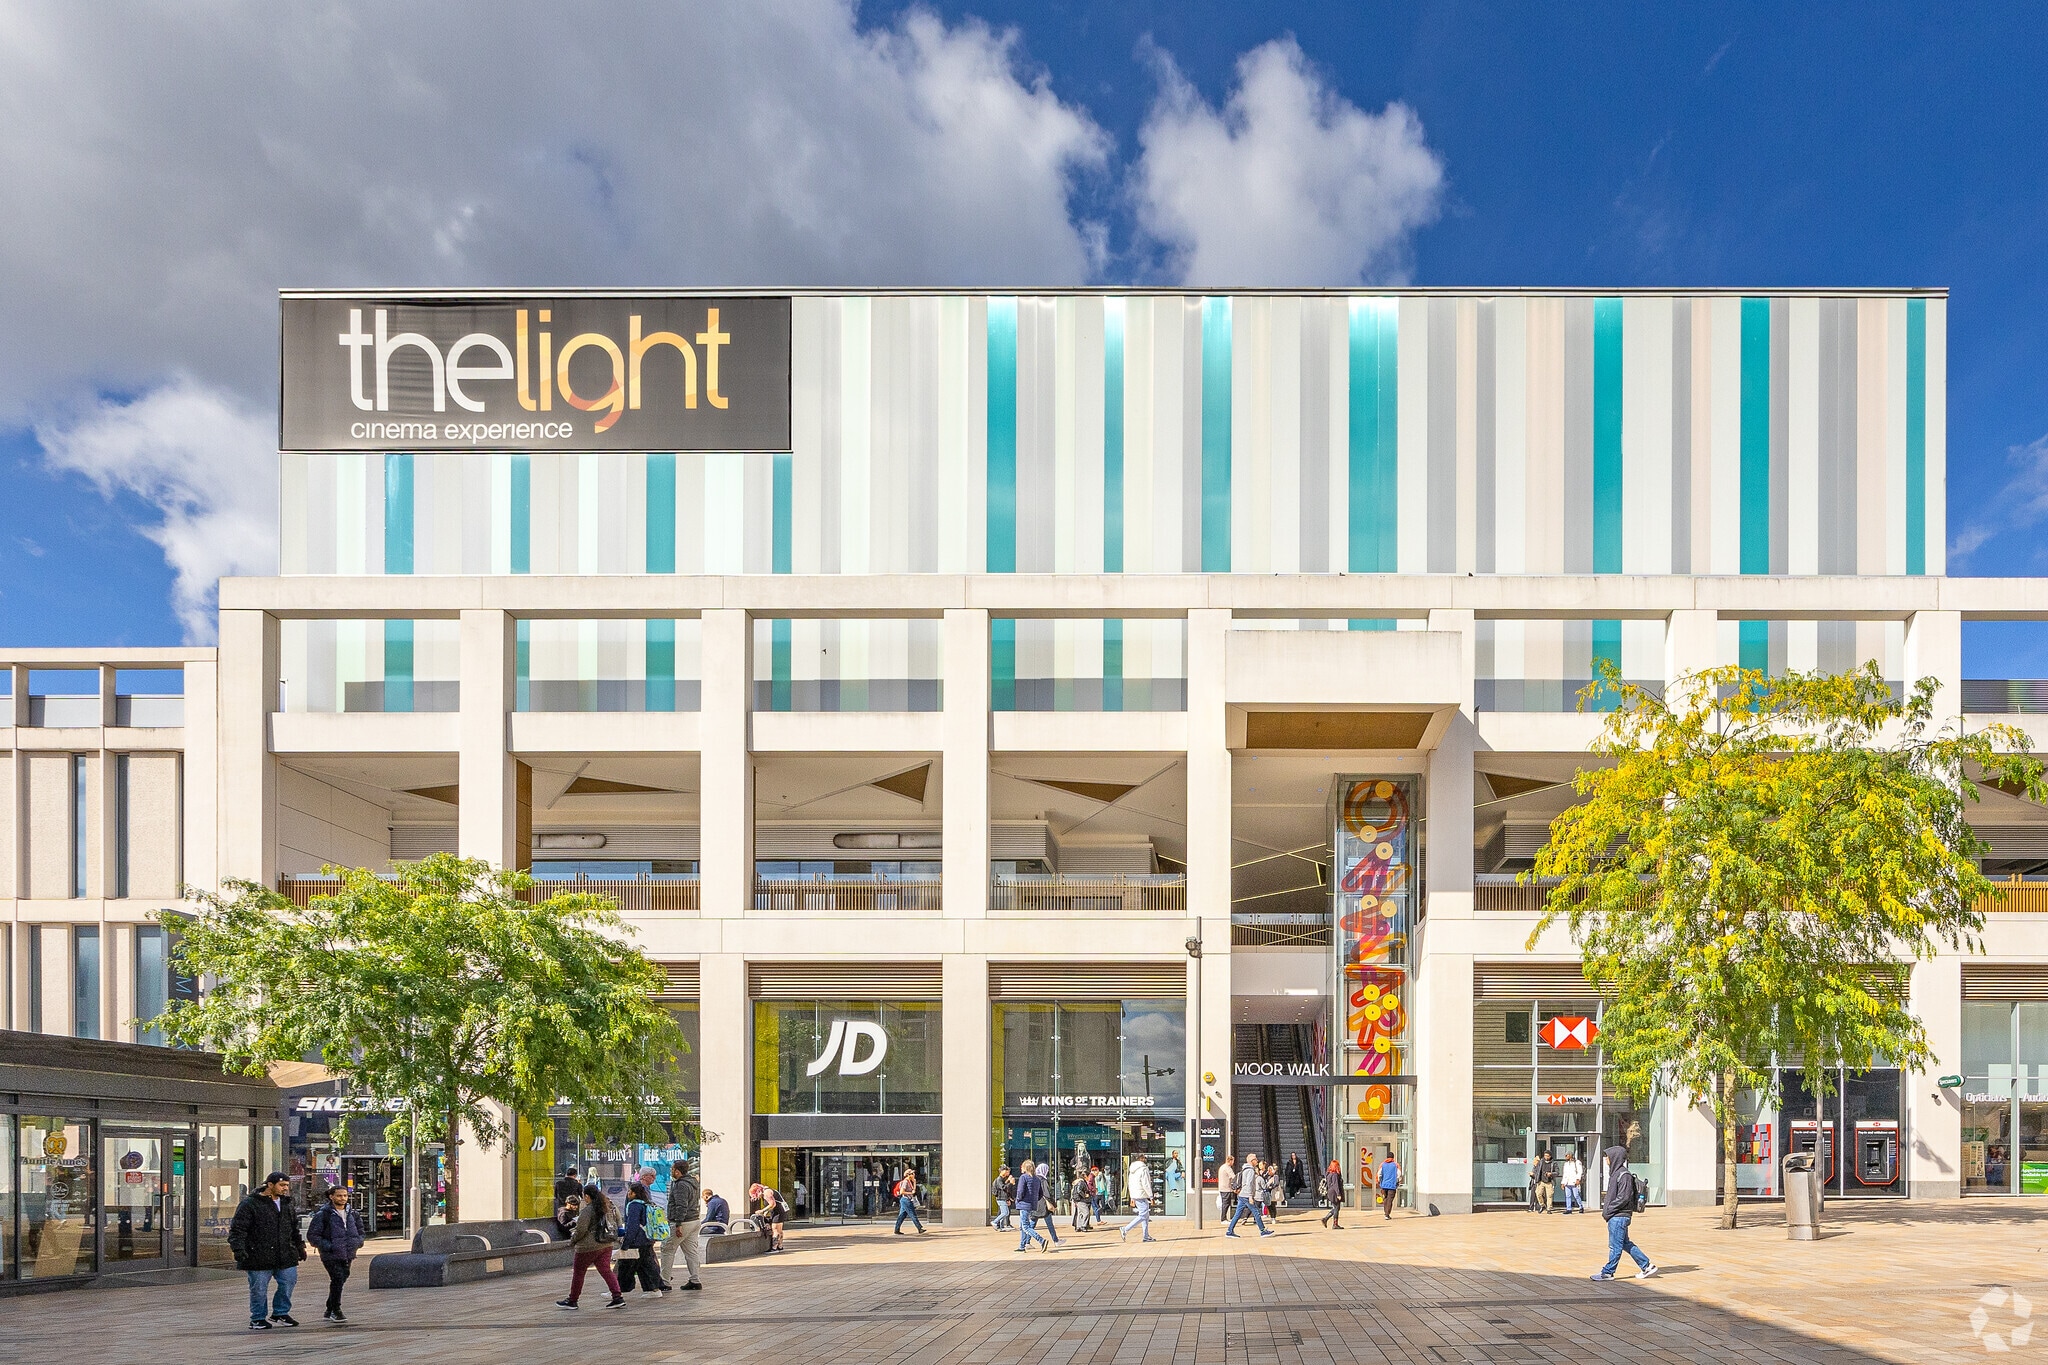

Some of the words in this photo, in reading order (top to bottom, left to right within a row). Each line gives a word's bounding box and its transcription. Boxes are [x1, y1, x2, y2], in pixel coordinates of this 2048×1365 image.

[350, 421, 438, 441] cinema
[444, 420, 573, 445] experience
[806, 1021, 888, 1077] JD
[1234, 1062, 1283, 1076] MOOR
[1287, 1063, 1330, 1077] WALK
[1042, 1096, 1074, 1106] KING
[1089, 1096, 1155, 1106] TRAINERS
[1965, 1092, 2008, 1105] Opticians
[531, 1136, 547, 1151] JD
